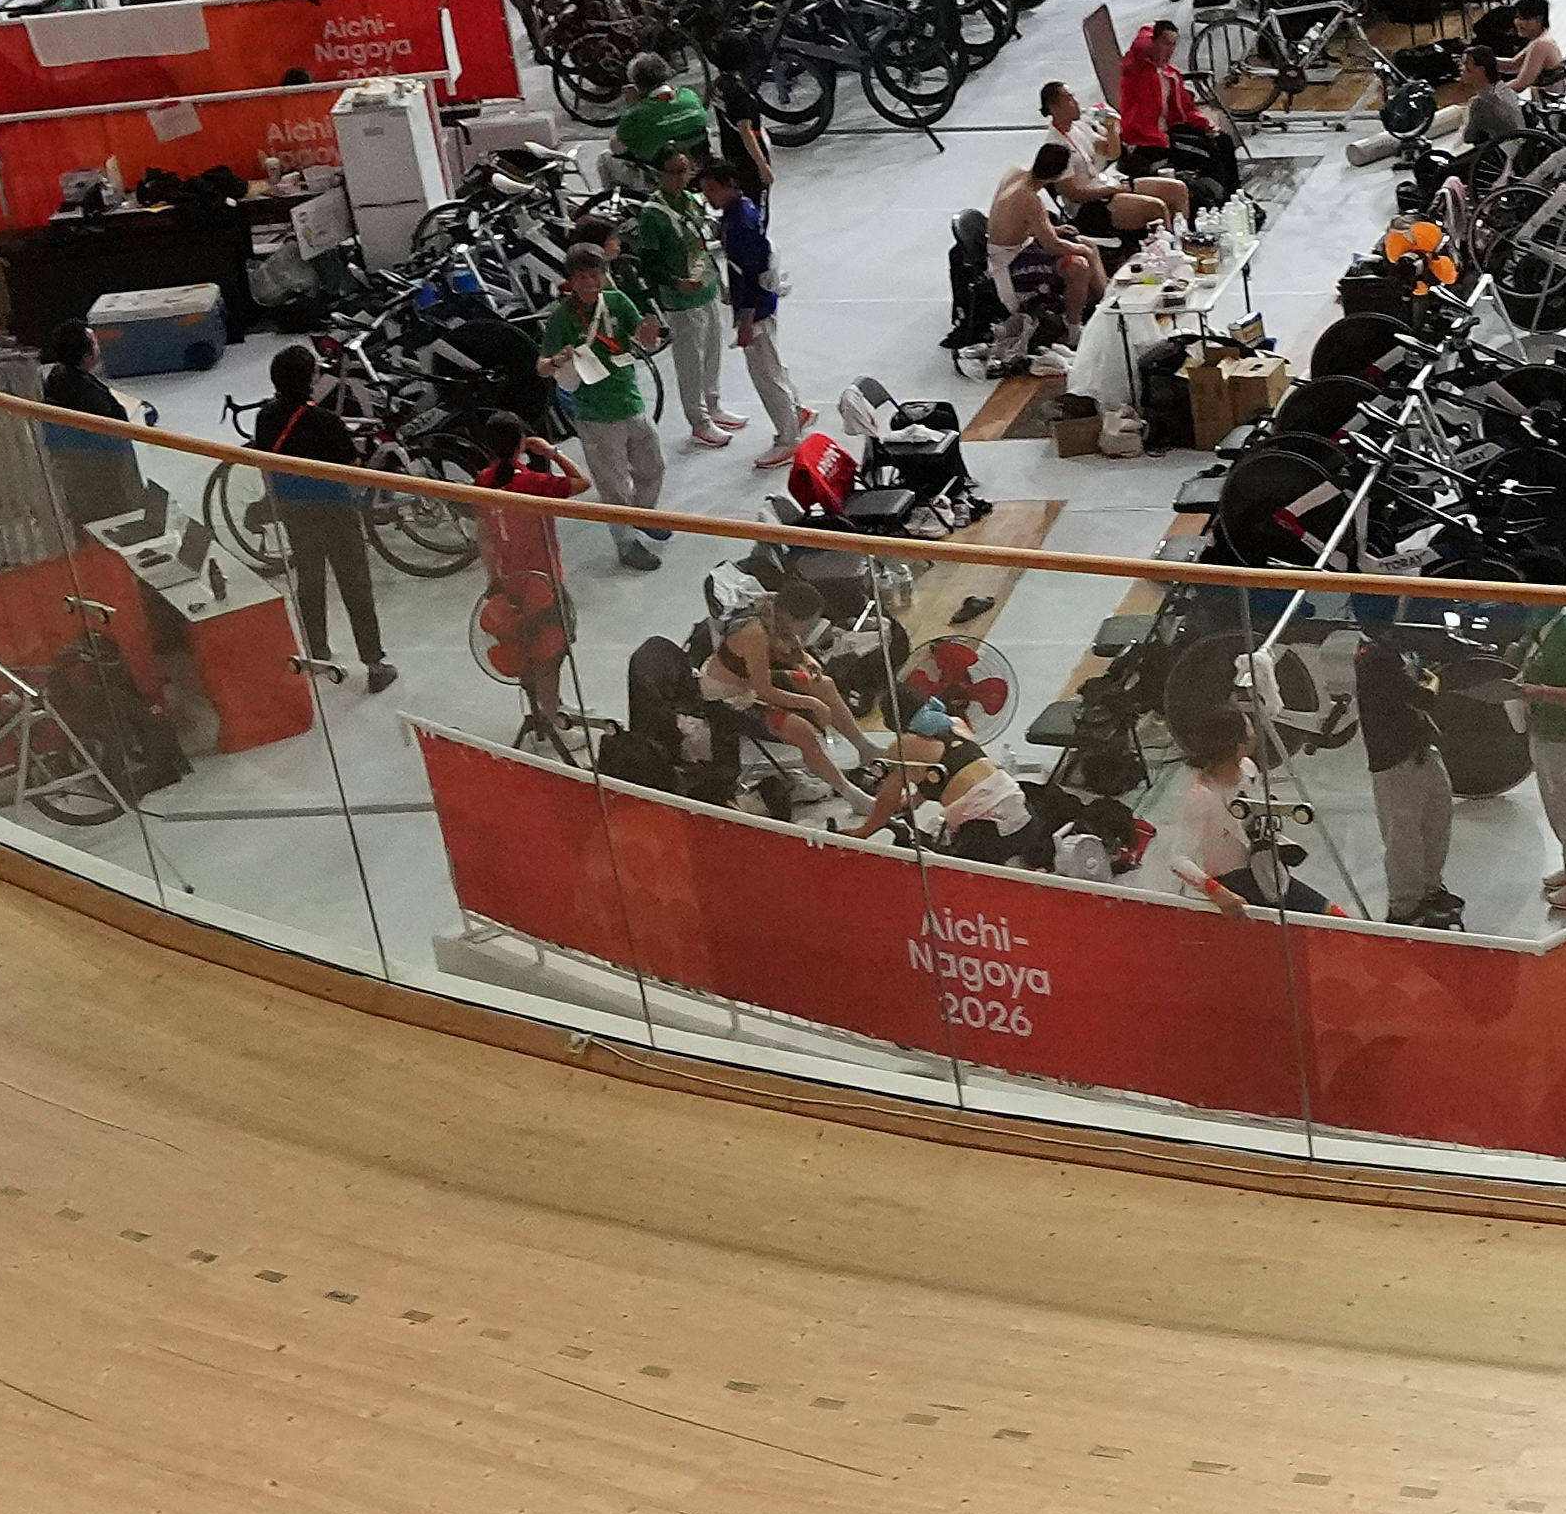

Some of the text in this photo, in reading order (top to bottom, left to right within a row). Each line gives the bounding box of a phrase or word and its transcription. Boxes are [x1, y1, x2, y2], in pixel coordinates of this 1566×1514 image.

[323, 13, 395, 40] Aichi-
[314, 38, 413, 67] Nagoya
[920, 909, 1030, 955] Aichi-
[908, 939, 1051, 997] Nagoya
[940, 993, 1033, 1038] 2026
